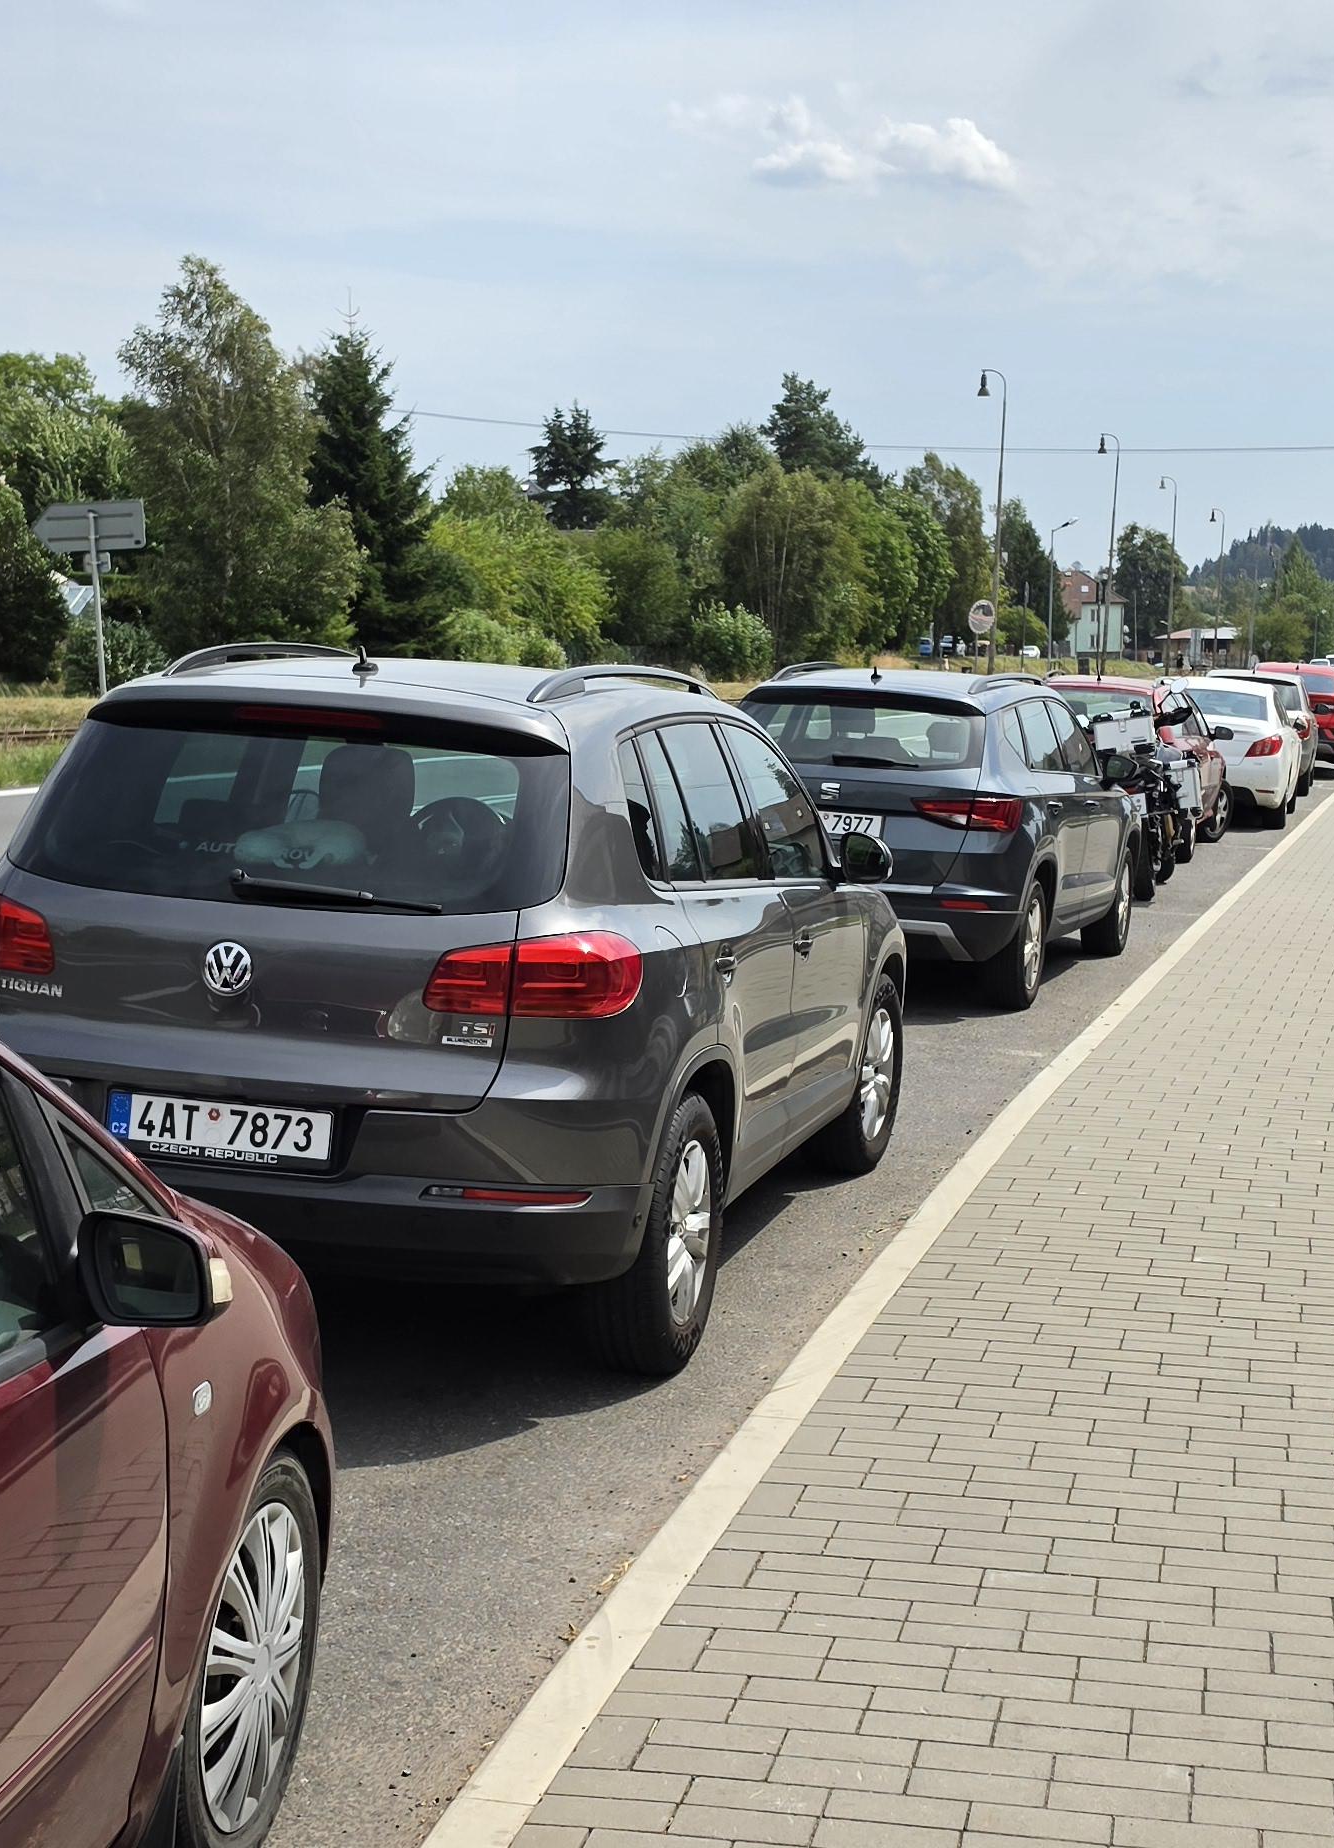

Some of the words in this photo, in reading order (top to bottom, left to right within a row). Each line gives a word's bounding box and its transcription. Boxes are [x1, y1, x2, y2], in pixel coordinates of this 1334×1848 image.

[831, 814, 873, 833] 7977
[0, 976, 63, 998] TIGUAN
[111, 1121, 127, 1134] CZ
[137, 1101, 200, 1141] 4AT
[227, 1108, 313, 1153] 7873
[149, 1142, 200, 1157] CZECH
[204, 1147, 278, 1164] REPUBLIC
